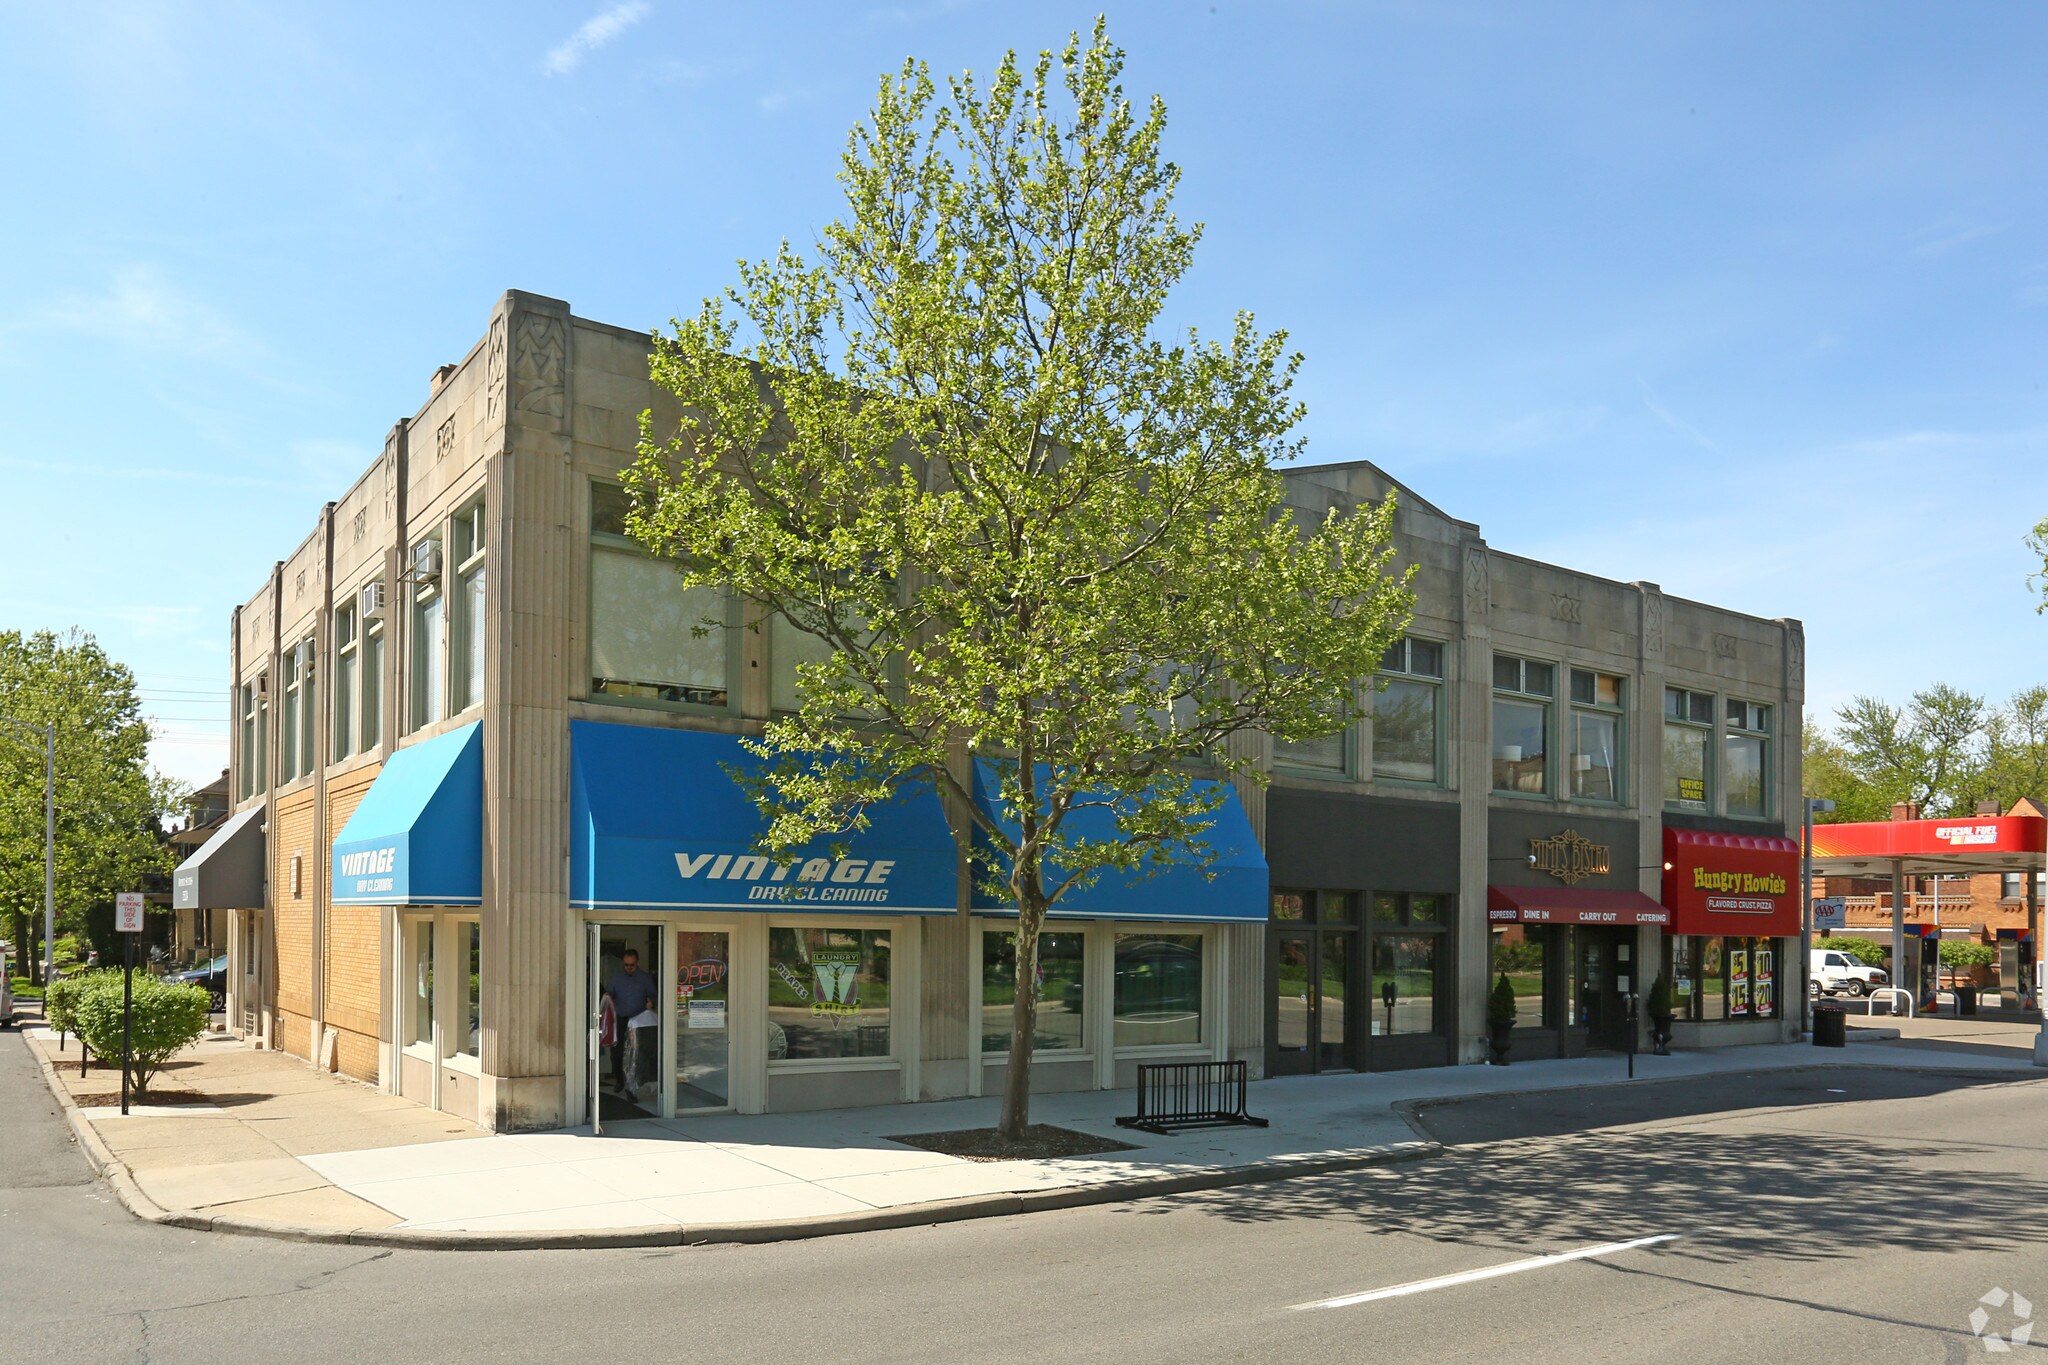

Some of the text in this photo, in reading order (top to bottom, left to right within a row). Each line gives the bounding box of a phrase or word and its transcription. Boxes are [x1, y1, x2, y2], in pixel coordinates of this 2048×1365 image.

[1680, 779, 1704, 790] OFFICE
[1681, 789, 1703, 799] SPACE
[1935, 825, 1997, 839] OFFICIAL FUEL
[341, 848, 396, 877] VINTAGE
[1530, 841, 1610, 873] MIMI'S BISTRO
[674, 853, 896, 884] VINTAGE
[1693, 867, 1786, 894] Hungry Howie's
[748, 886, 889, 902] DRY CLEANING
[1709, 900, 1737, 908] FLAVORED
[1756, 902, 1772, 910] PIZZA
[1816, 905, 1833, 916] AAA
[1490, 910, 1516, 919] ESPRESSO
[1524, 910, 1549, 919] DINE IN
[1579, 912, 1616, 921] CARRY OUT
[1636, 913, 1666, 922] CATERING
[677, 965, 722, 984] OPEN
[776, 964, 808, 999] DRAPES
[816, 1003, 856, 1014] SHIRT
